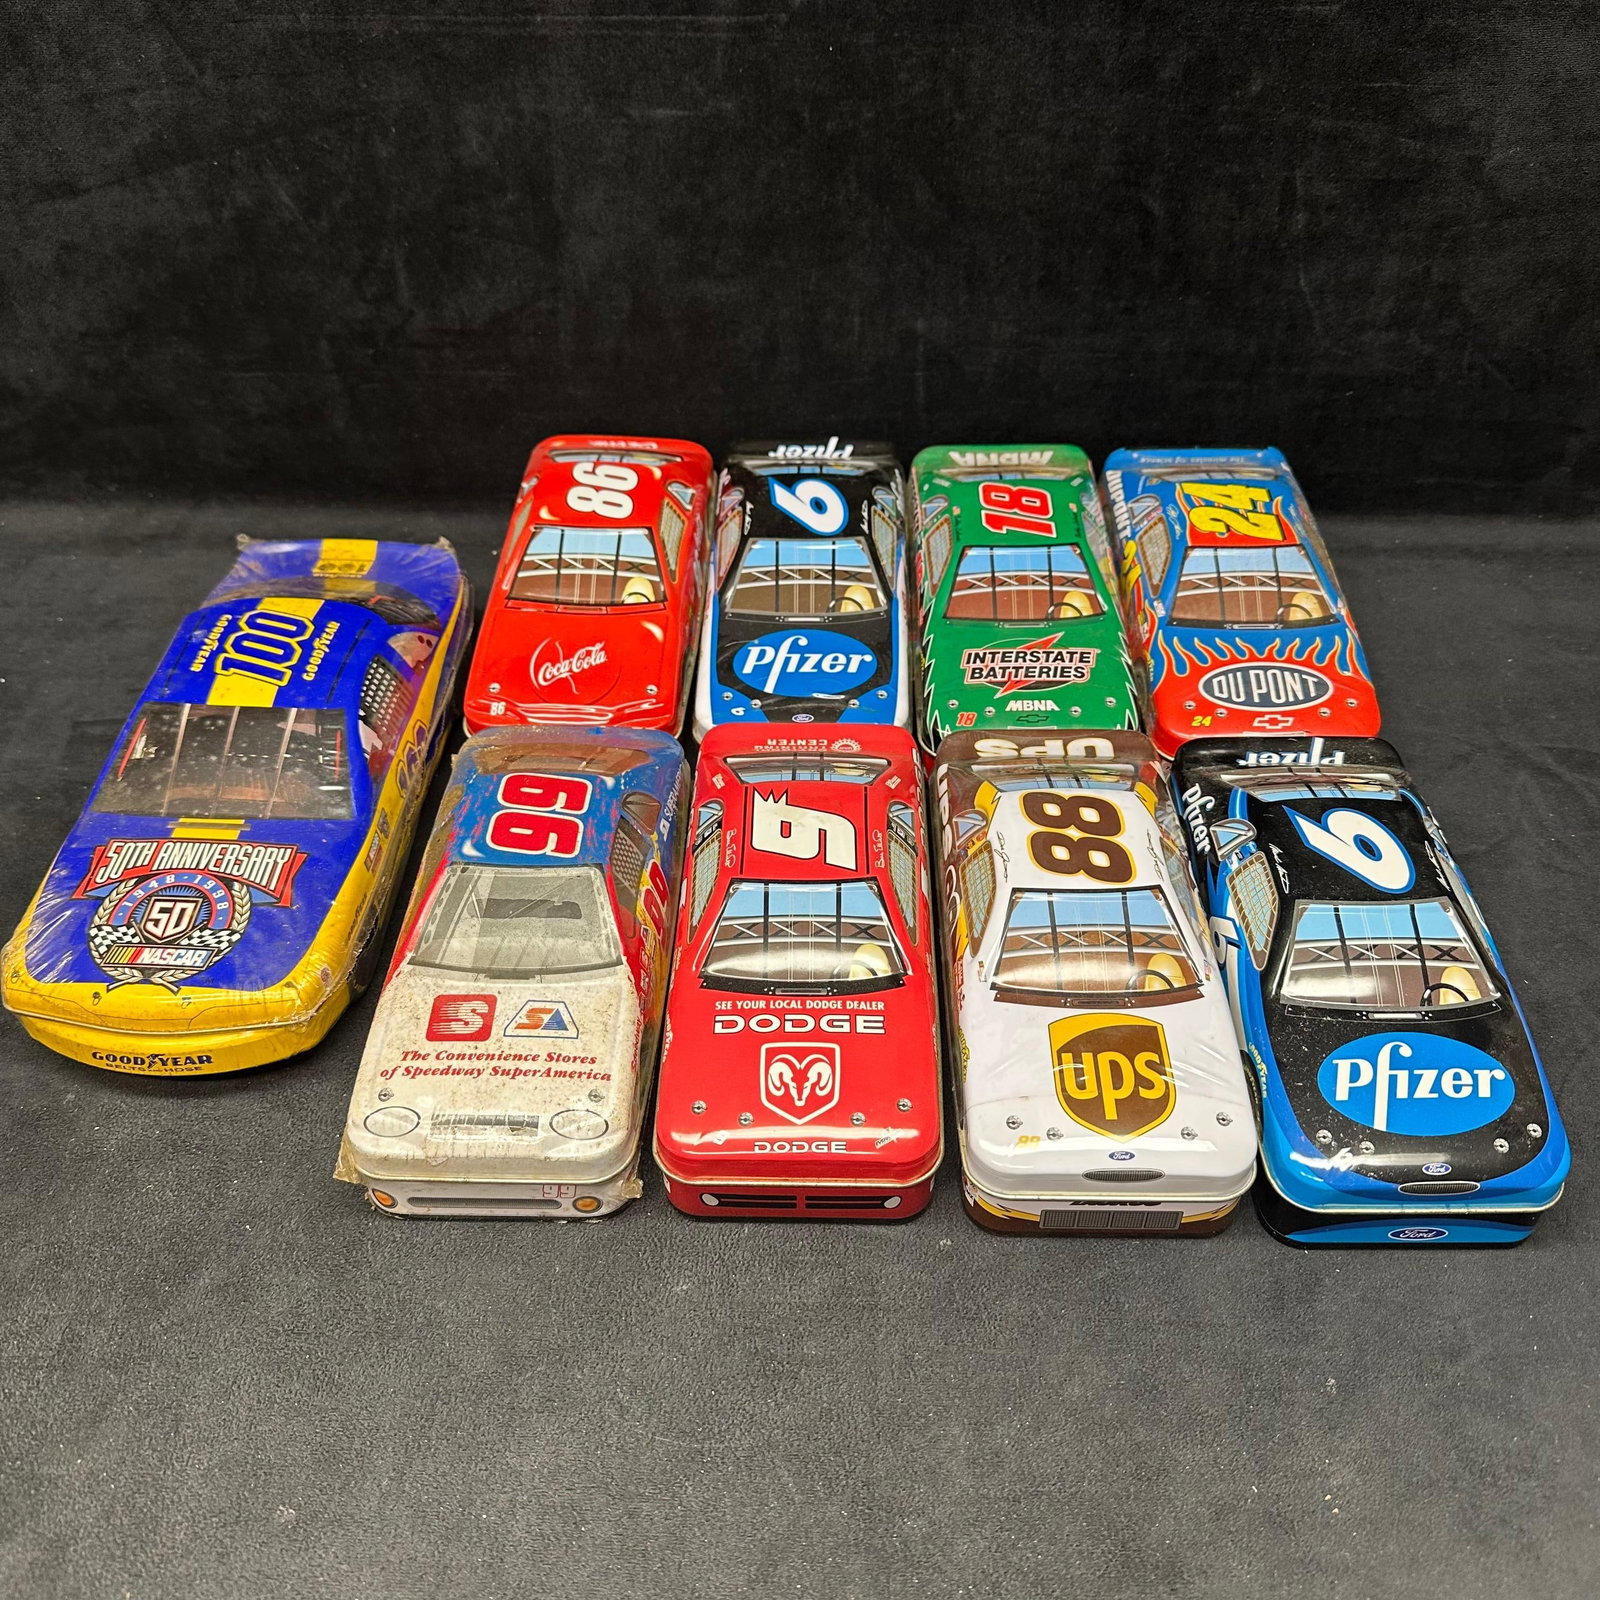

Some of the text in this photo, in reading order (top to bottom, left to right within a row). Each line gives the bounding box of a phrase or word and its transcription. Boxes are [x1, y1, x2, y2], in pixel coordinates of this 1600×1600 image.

[768, 436, 854, 459] Pfizer
[566, 461, 639, 519] 86
[768, 477, 849, 536] 6
[979, 482, 1057, 538] 18
[1181, 482, 1286, 541] 24
[214, 609, 315, 686] 100
[302, 621, 340, 681] GOODYEAR
[965, 650, 1092, 665] INTERSTATE
[742, 635, 873, 694] Pfizer
[969, 666, 1087, 680] BATTERIES
[1250, 668, 1318, 704] PONT
[489, 702, 506, 715] 86
[1005, 700, 1060, 711] MBNA
[956, 712, 977, 726] 18
[1191, 715, 1212, 727] 24
[974, 737, 1114, 759] UPS
[1236, 737, 1345, 766] Pfizer
[486, 773, 593, 858] 99
[1182, 783, 1216, 855] Pfizer
[751, 788, 857, 871] 9
[1019, 790, 1137, 885] 88
[1282, 805, 1416, 894] 6
[95, 841, 291, 890] 50TH ANNIVERSARY
[147, 902, 197, 938] 50
[138, 948, 208, 967] NASCAR
[715, 1000, 885, 1010] SEE YOUR LOCAL DODGE DEALER
[713, 1013, 886, 1034] DODGE
[91, 1051, 213, 1070] GOODYEAR
[105, 1062, 146, 1072] BELTS
[401, 1050, 598, 1065] The Convenience Stores
[380, 1065, 612, 1082] of Speedway SuperAmerica
[1061, 1051, 1166, 1120] ups
[1332, 1041, 1506, 1132] Pfizer
[753, 1141, 847, 1153] DODGE
[1427, 1163, 1447, 1174] Ford
[543, 1184, 577, 1198] 99
[1400, 1228, 1438, 1239] Ford
